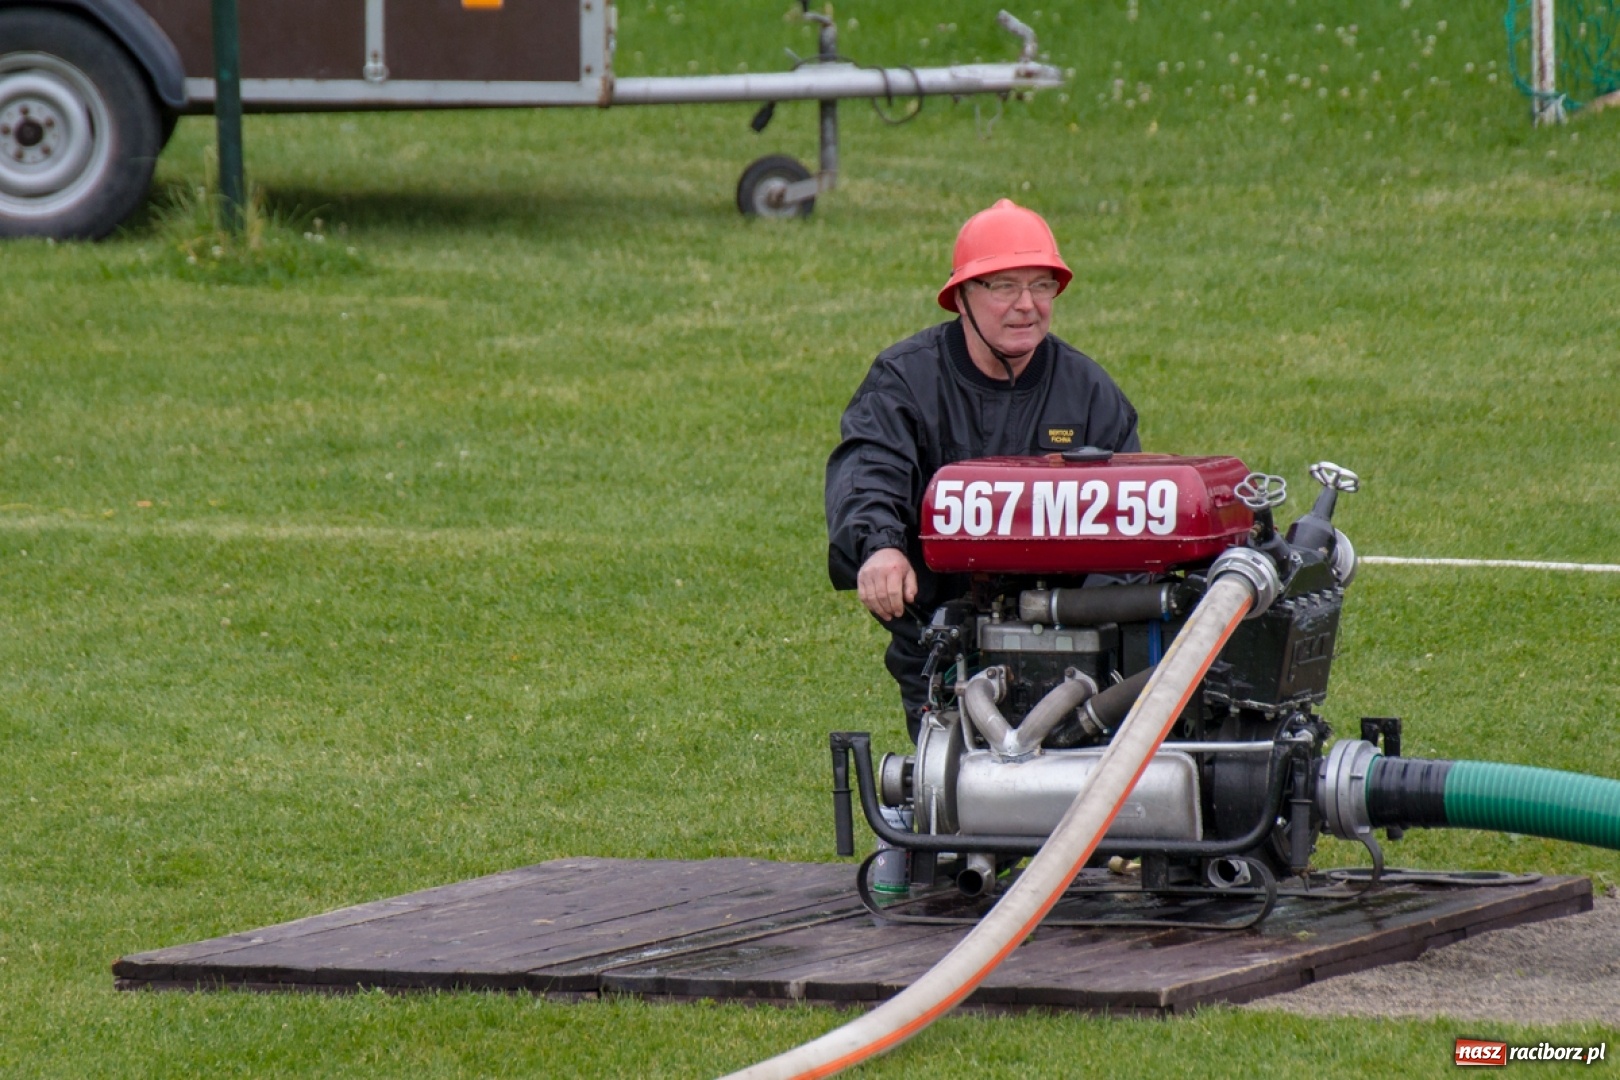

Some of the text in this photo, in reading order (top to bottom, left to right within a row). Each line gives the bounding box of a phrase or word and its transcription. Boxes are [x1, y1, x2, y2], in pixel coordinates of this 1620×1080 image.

[933, 479, 1178, 537] 567 M2 59
